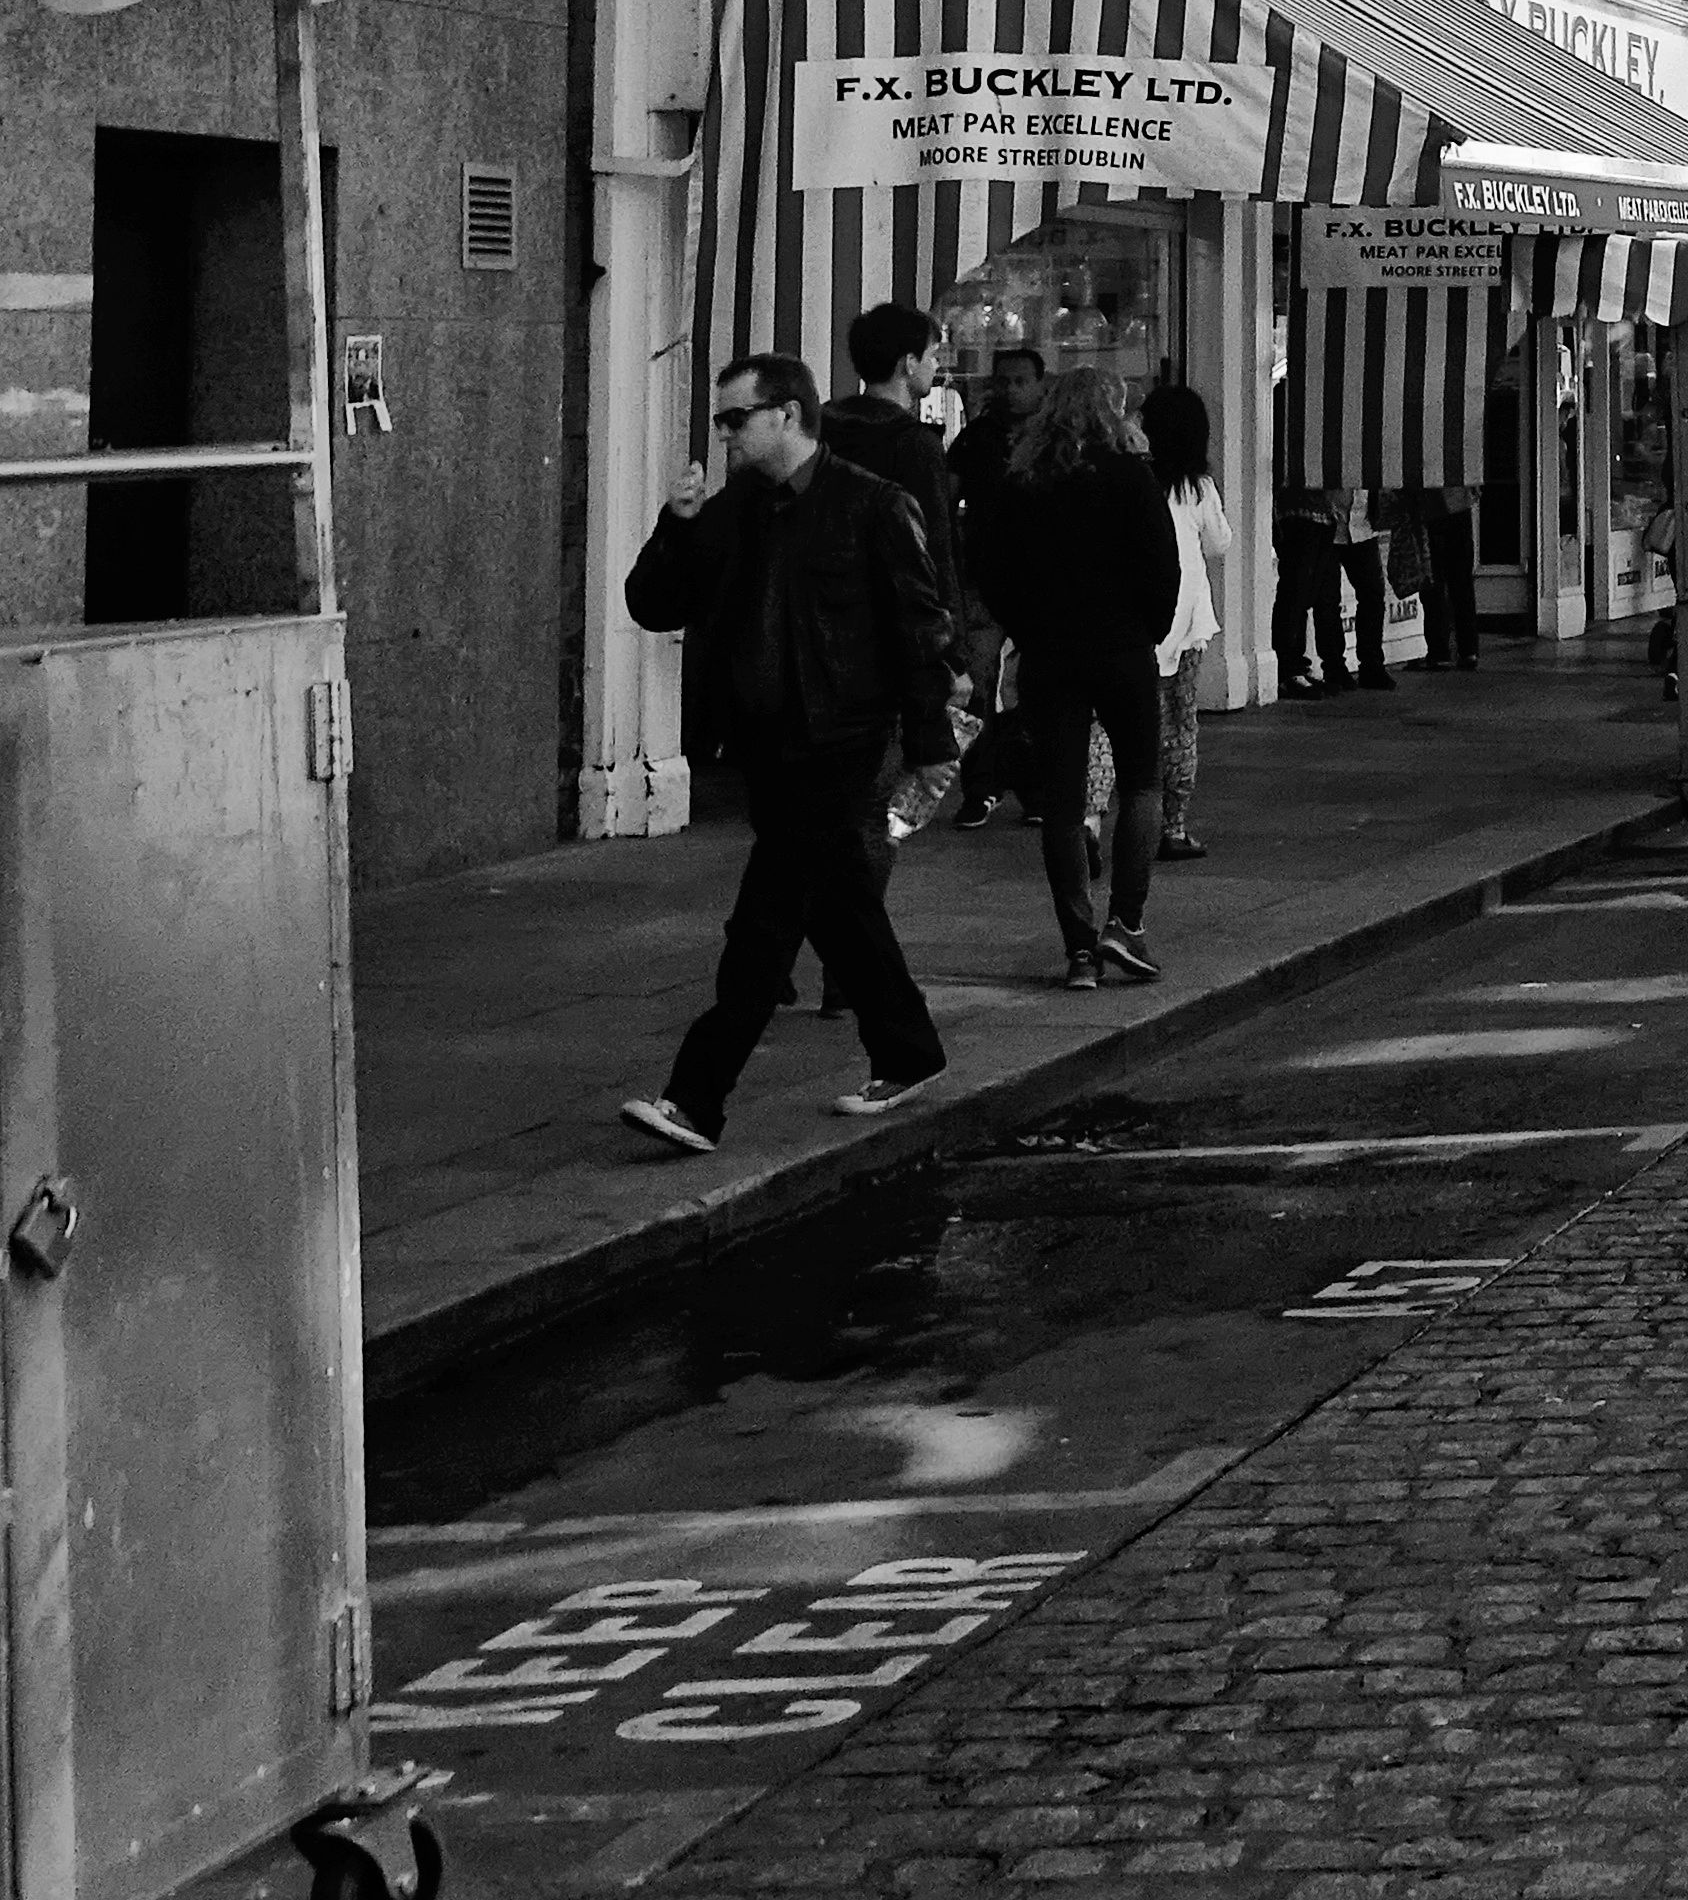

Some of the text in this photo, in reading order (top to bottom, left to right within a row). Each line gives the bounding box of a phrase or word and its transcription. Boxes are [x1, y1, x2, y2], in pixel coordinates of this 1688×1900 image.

[836, 68, 1233, 106] F.X. BUCKLEY LTD.
[892, 113, 1172, 142] MEAT PAR EXCELLENCE
[919, 146, 1146, 171] MOORE STREET DUBLIN
[1481, 179, 1551, 216] BUCKLEY
[1552, 190, 1581, 218] LTD.
[1618, 195, 1642, 222] MEAT
[1325, 221, 1373, 238] F.X.
[1360, 245, 1408, 260] MEAT
[1416, 245, 1449, 259] PAR
[1381, 265, 1432, 278] MOORE
[1436, 265, 1483, 278] STREET
[615, 1549, 1089, 1742] CLEAR
